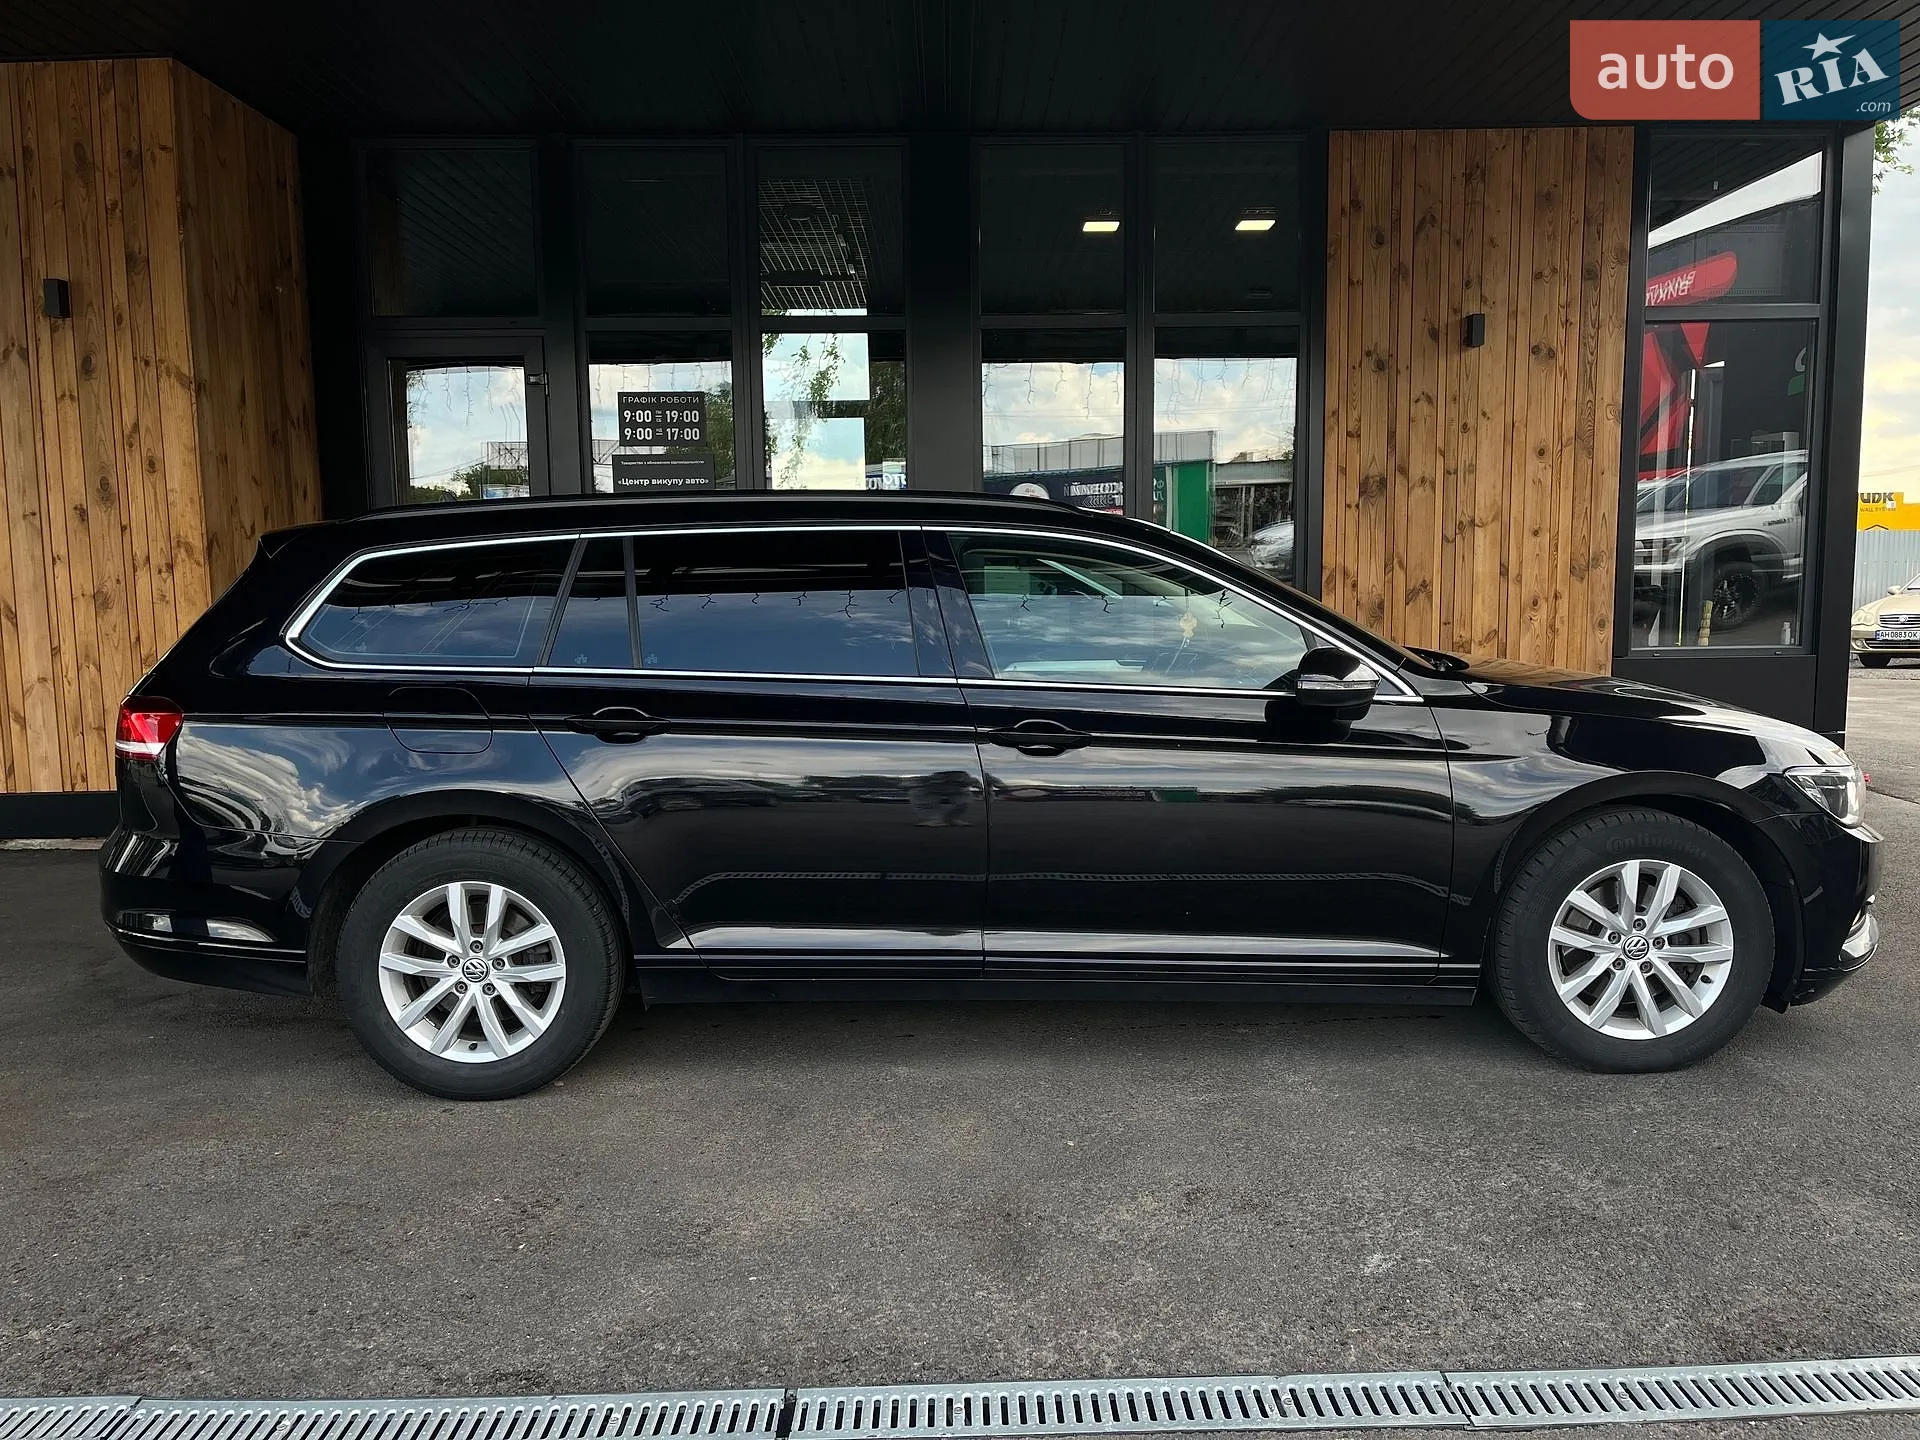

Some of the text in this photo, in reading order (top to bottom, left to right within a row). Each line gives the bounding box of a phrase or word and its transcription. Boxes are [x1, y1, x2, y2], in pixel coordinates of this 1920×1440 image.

[622, 396, 700, 404] ГРАФІК РОБОТИ
[623, 410, 700, 423] 9:00 19:00
[624, 428, 700, 440] 9:00 17:00
[1860, 492, 1895, 504] UDK
